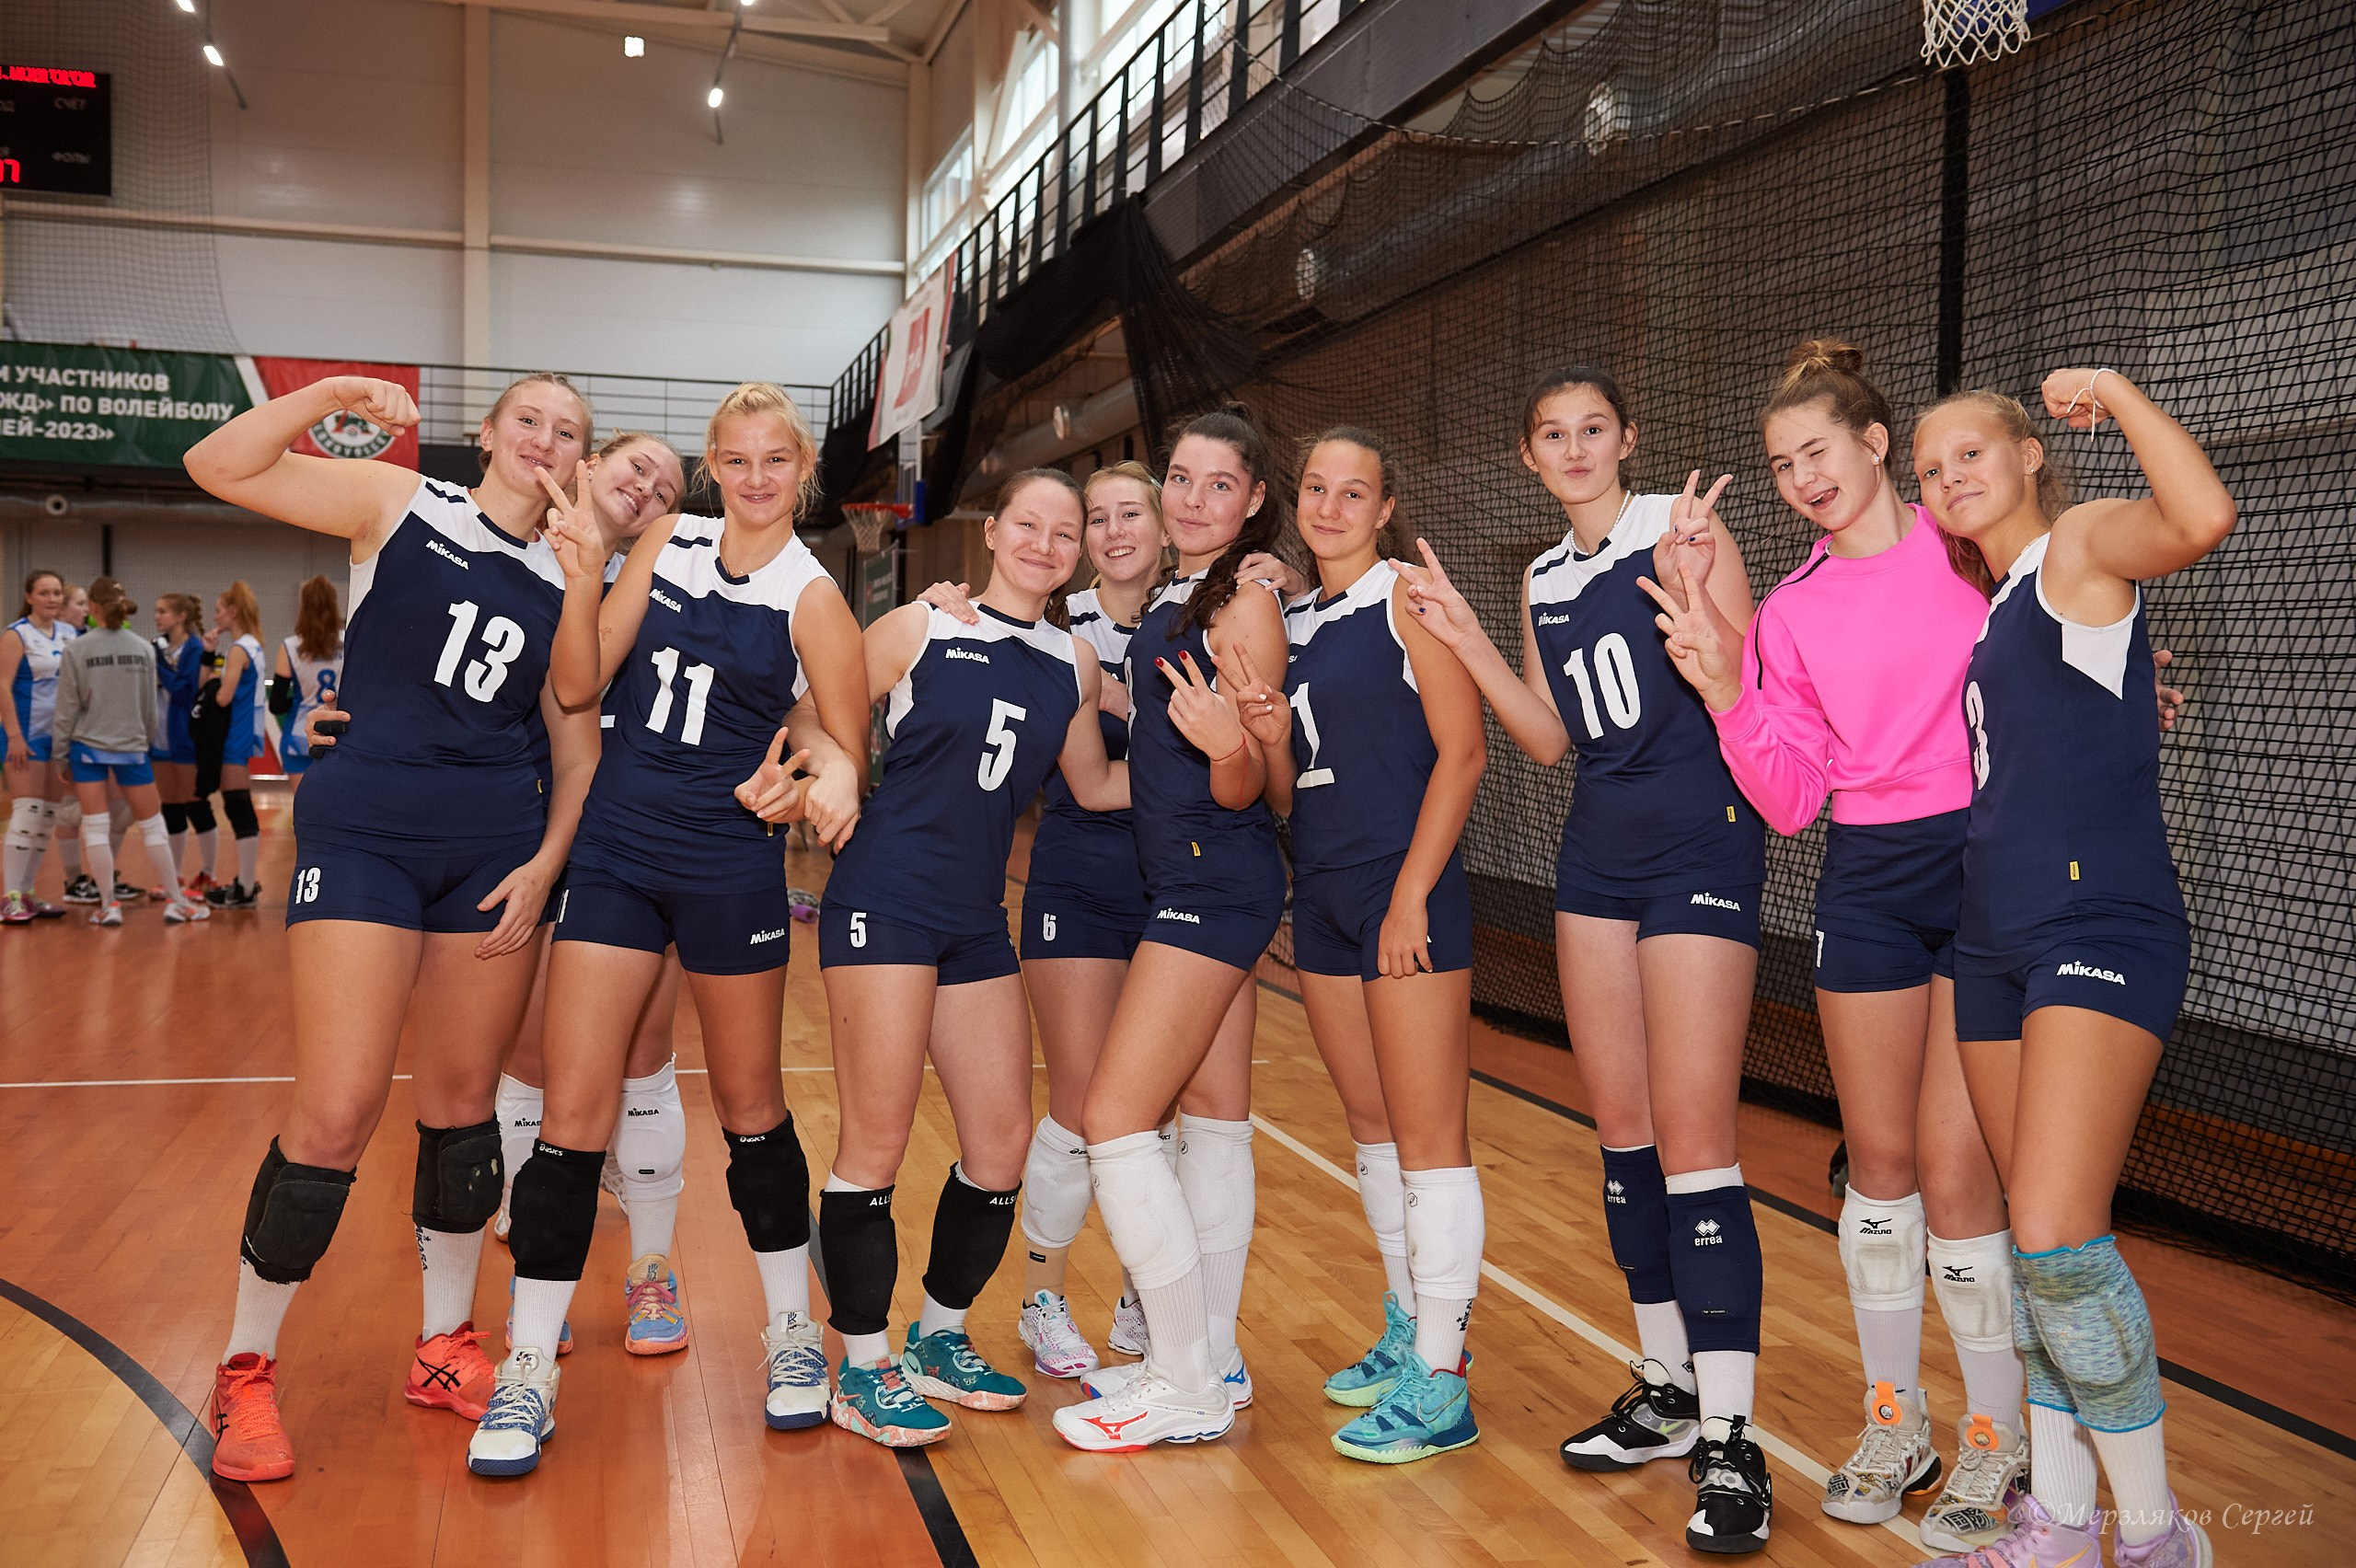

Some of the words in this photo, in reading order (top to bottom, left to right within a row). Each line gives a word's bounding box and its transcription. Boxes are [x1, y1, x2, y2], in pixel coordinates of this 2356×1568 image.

[16, 366, 169, 392] УЧАСТНИКОВ
[60, 396, 91, 413] ПО
[98, 396, 235, 421] ВОЛЕЙБОЛУ
[0, 417, 116, 441] ЕЙ-2023»
[433, 600, 525, 703] 13
[645, 646, 715, 746] 11
[1563, 632, 1641, 740] 10
[977, 698, 1027, 791] 5
[295, 867, 321, 905] 13
[849, 912, 867, 948] 5
[1043, 913, 1057, 941] 6
[514, 1117, 542, 1127] MIKAS
